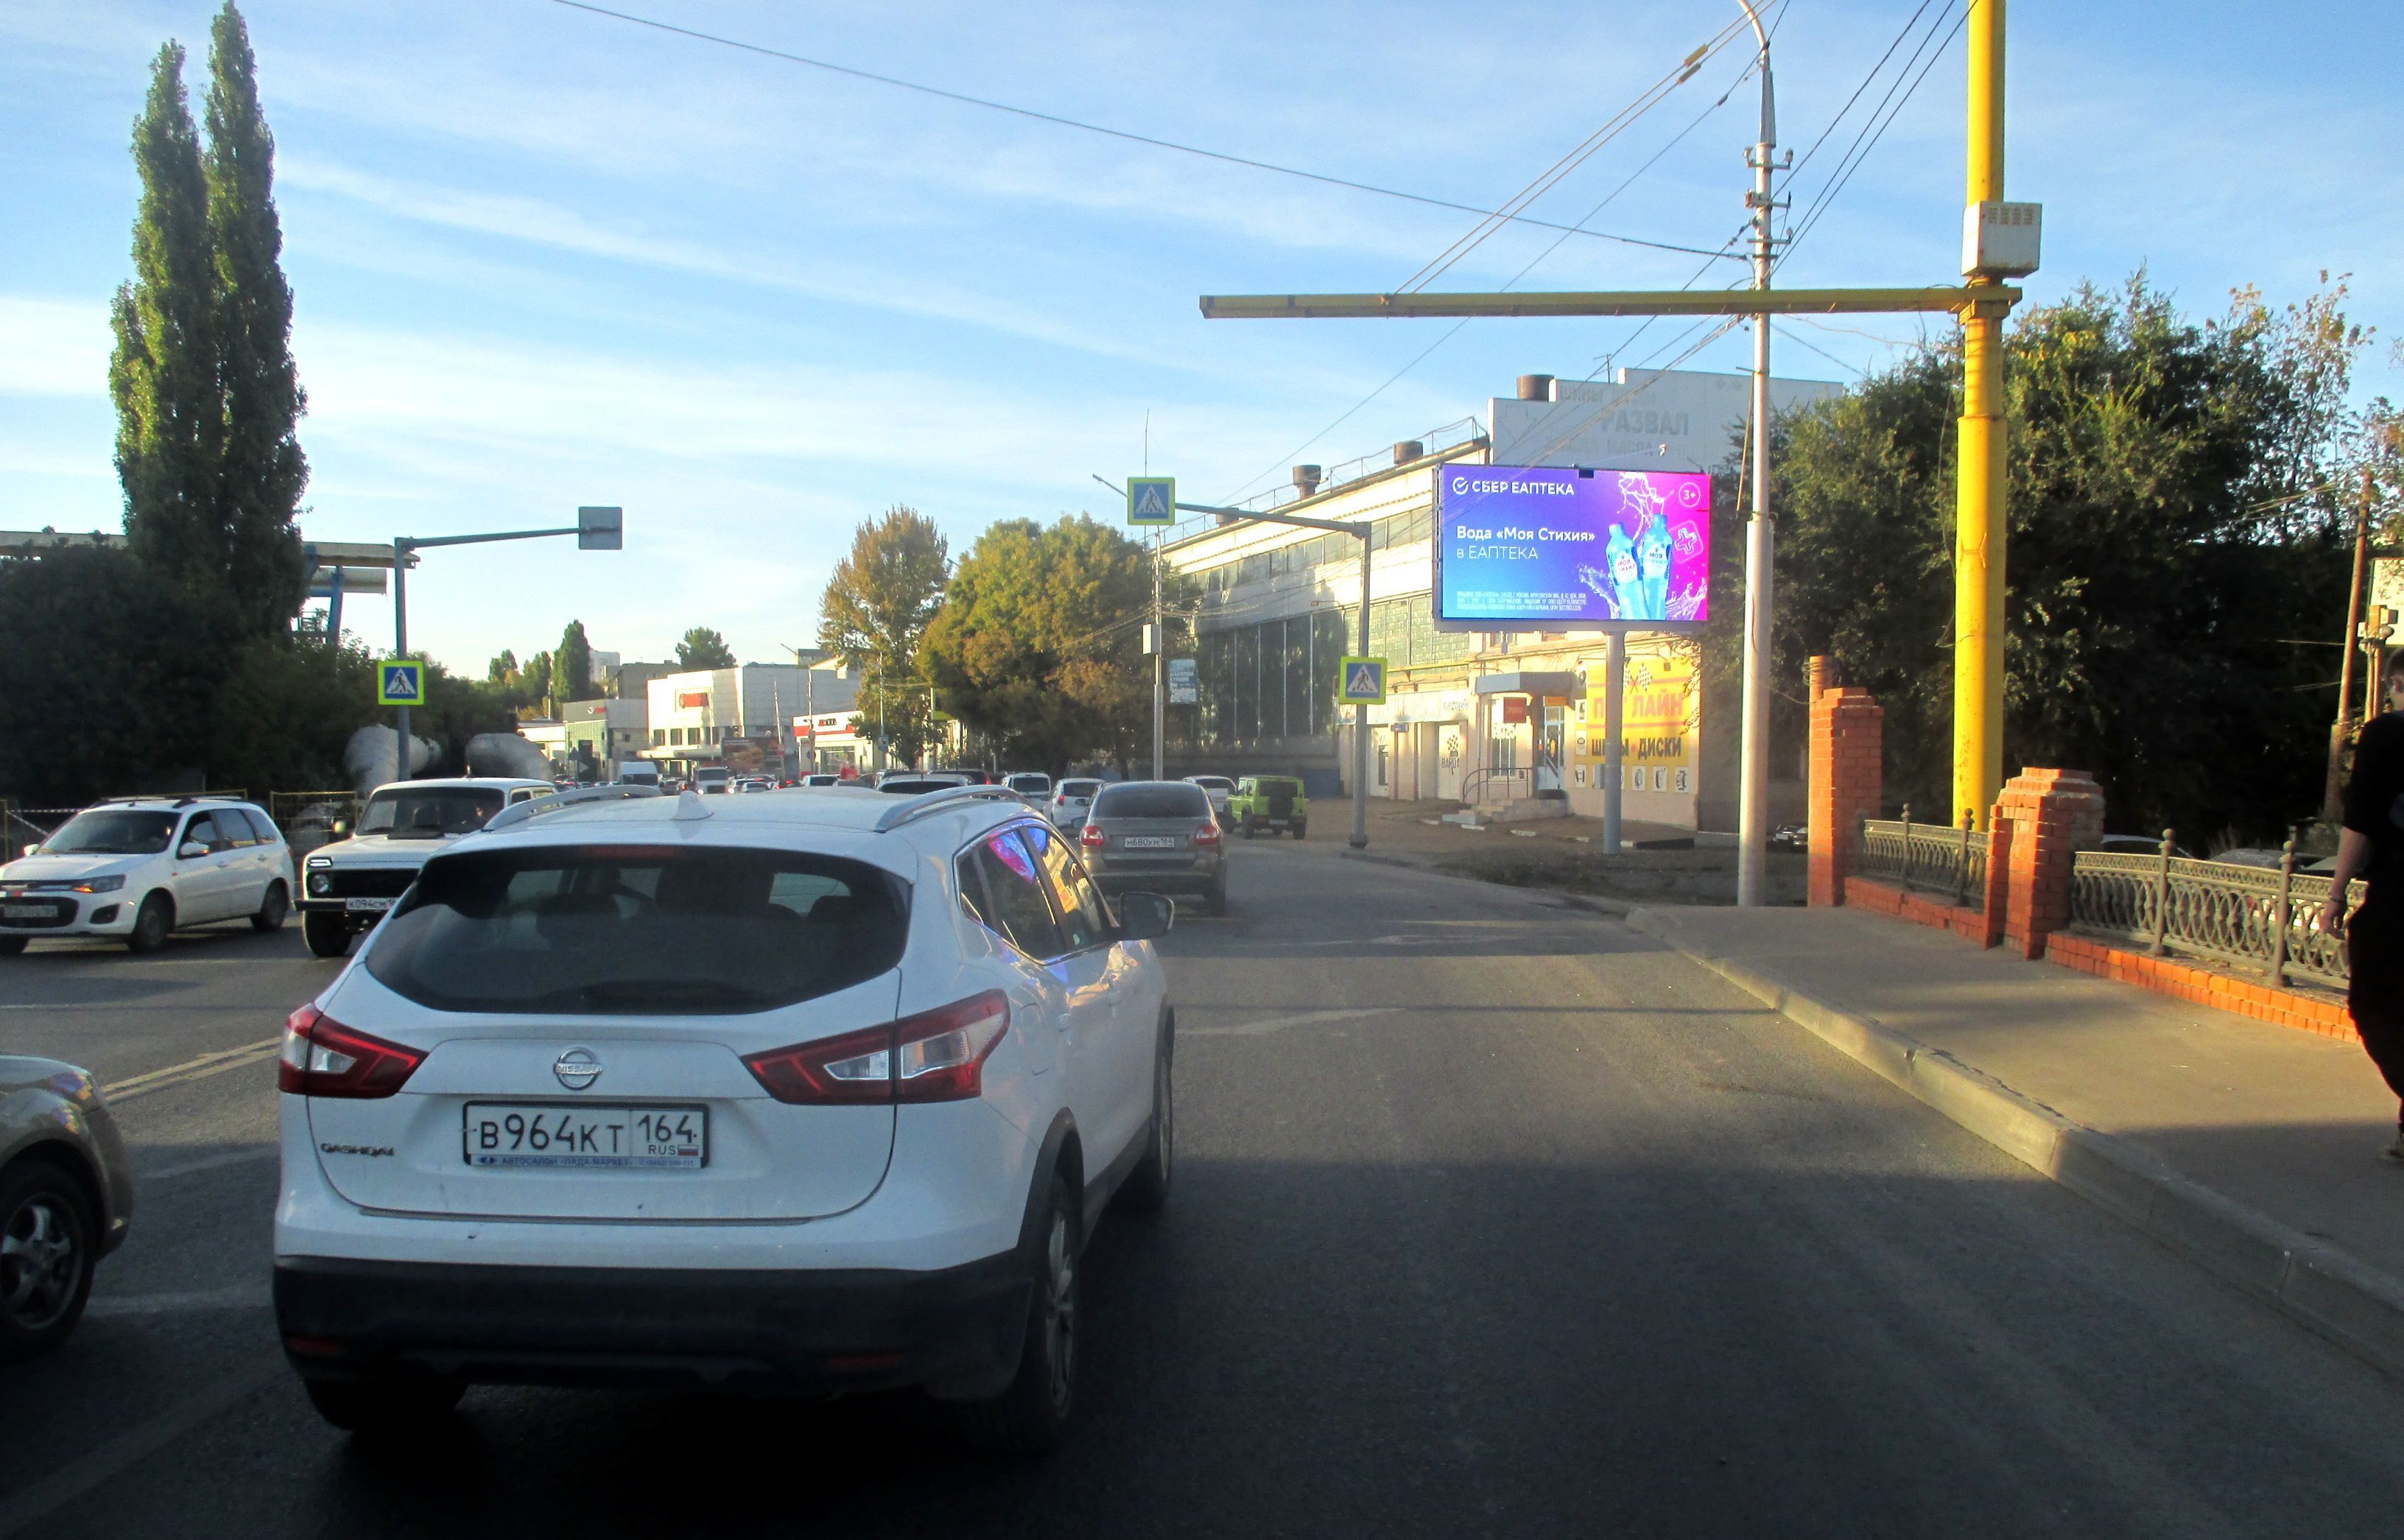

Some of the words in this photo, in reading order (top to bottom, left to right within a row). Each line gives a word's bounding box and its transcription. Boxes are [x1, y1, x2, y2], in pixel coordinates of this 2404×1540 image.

[1472, 480, 1509, 493] СБЕР
[1511, 481, 1575, 496] ЕАПТЕКА
[1683, 489, 1696, 500] 3+
[1456, 524, 1492, 541] Вода
[1496, 527, 1534, 541] «Моя
[1538, 527, 1596, 542] Стихия»
[1456, 548, 1464, 558] в
[1468, 545, 1539, 560] ЕАПТЕКА
[1631, 688, 1684, 717] ЛАЙН
[1591, 737, 1629, 757] ШЫ
[1637, 736, 1682, 760] ДИСКИ
[637, 1114, 695, 1143] 164
[648, 1144, 676, 1155] RUS
